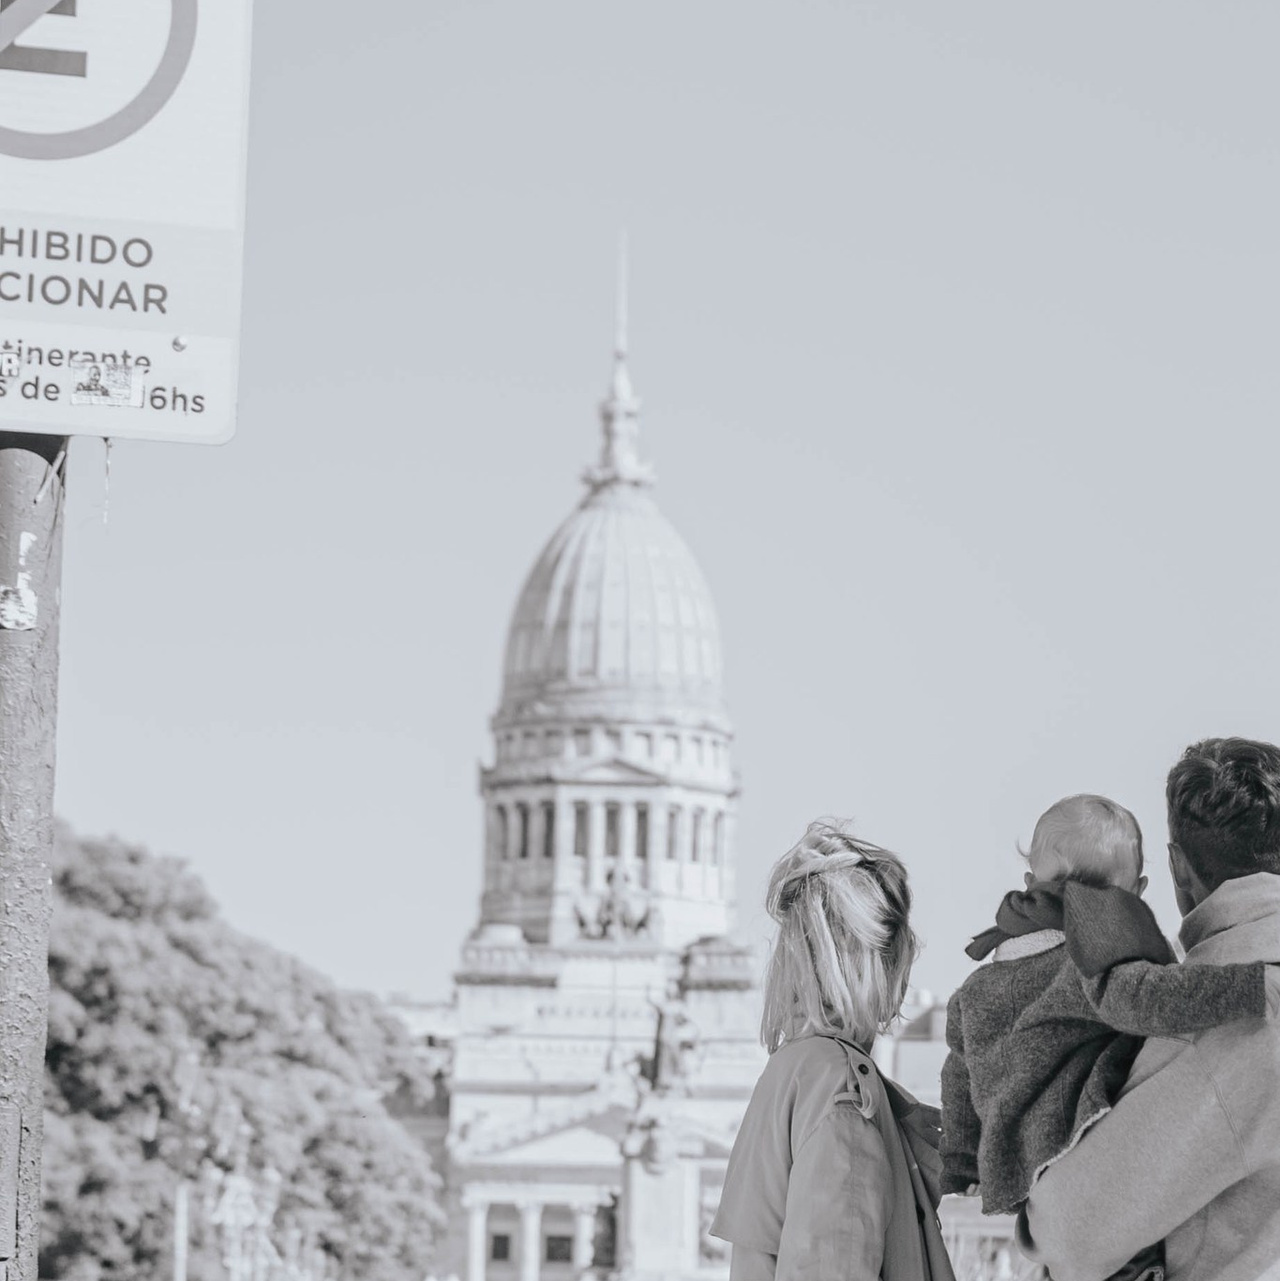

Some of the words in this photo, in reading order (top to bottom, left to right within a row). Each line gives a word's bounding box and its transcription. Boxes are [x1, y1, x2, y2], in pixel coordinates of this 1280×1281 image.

[0, 226, 153, 268] HIBIDO
[0, 271, 168, 315] CIONAR
[21, 375, 61, 401] de
